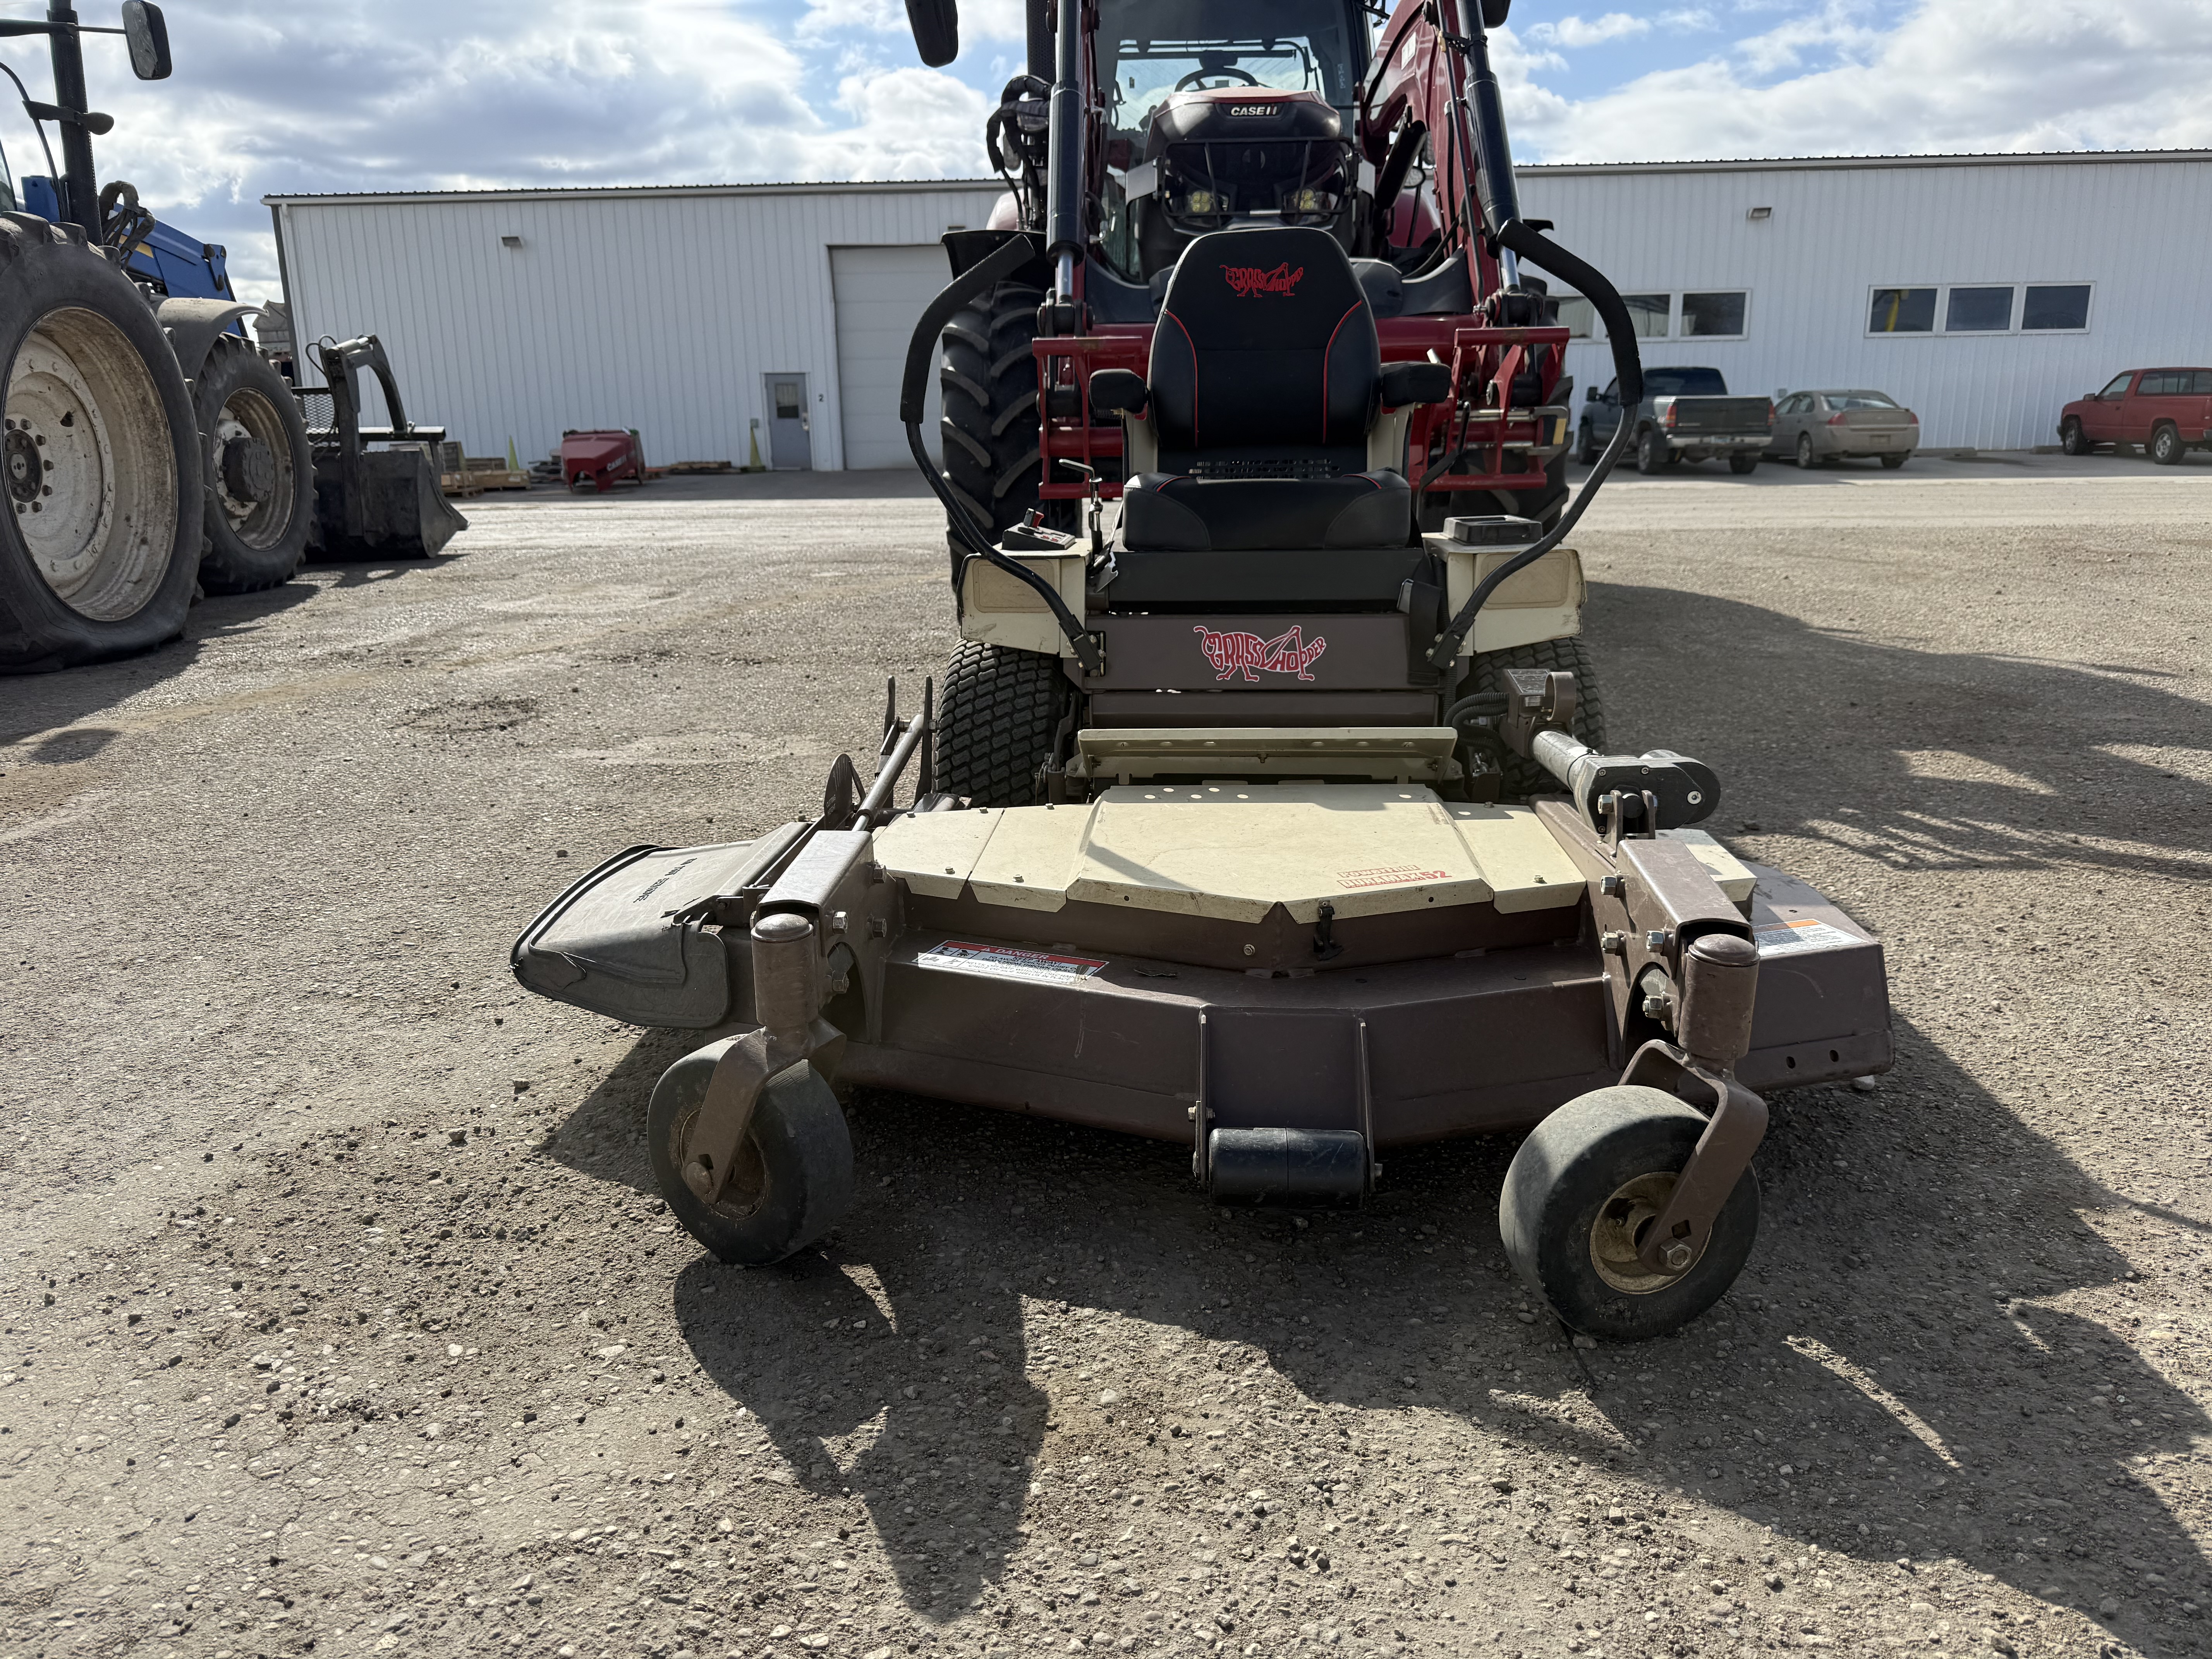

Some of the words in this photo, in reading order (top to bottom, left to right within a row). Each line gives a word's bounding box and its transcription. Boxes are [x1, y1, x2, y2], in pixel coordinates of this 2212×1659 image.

[1231, 106, 1265, 116] CASE
[818, 393, 824, 402] 2
[1194, 625, 1326, 682] GRASSHOPPER
[1419, 870, 1452, 879] 52
[995, 948, 1049, 959] DANGER
